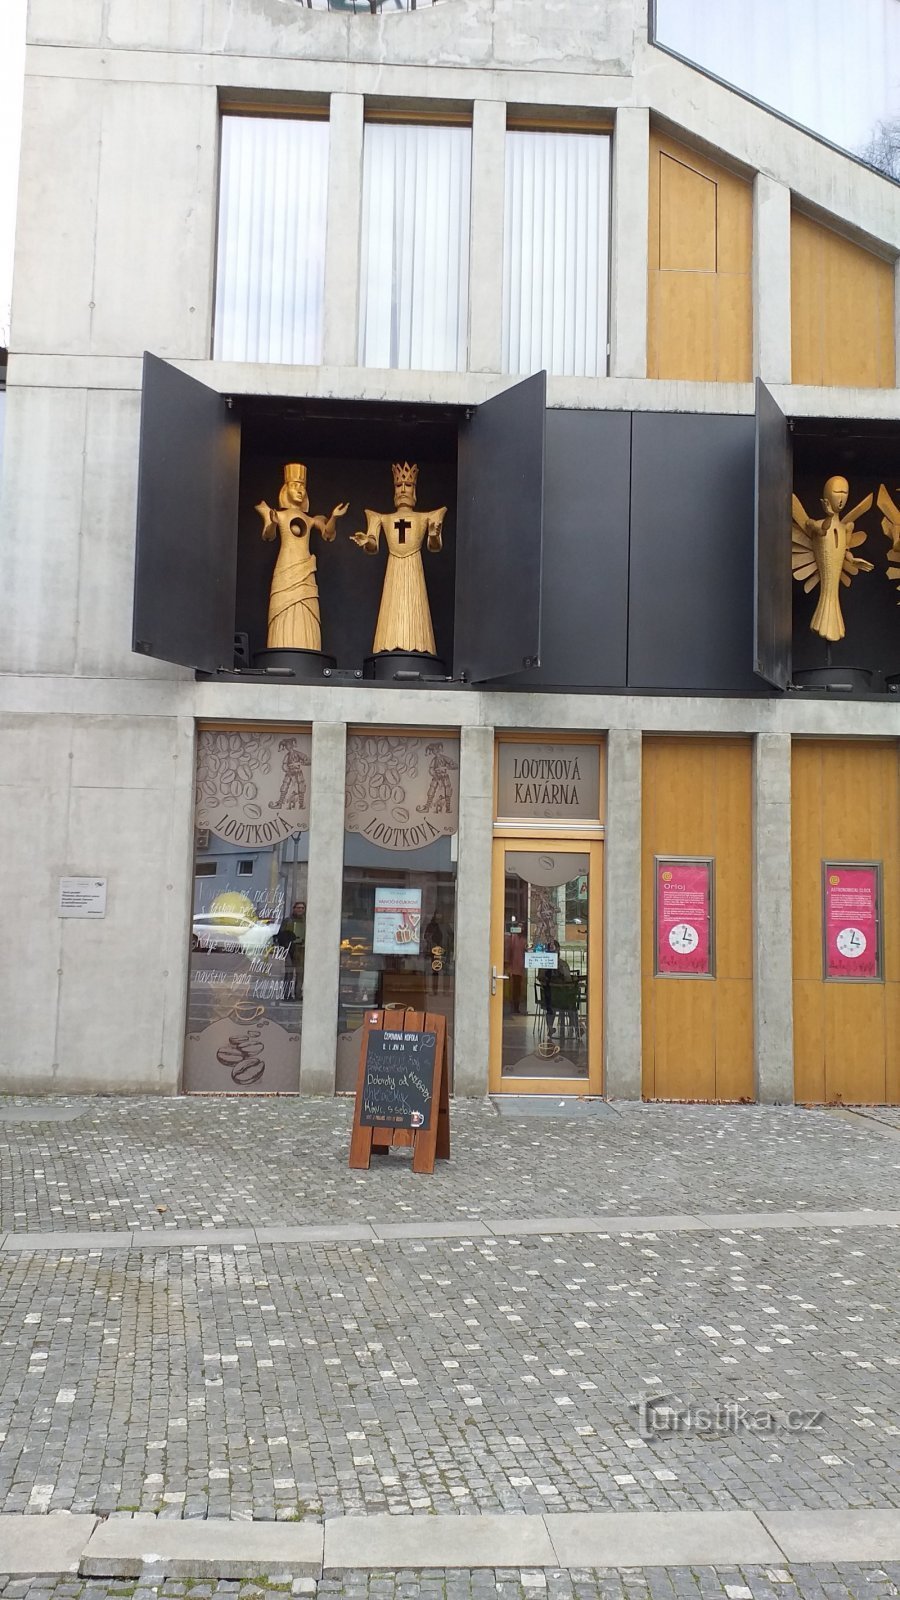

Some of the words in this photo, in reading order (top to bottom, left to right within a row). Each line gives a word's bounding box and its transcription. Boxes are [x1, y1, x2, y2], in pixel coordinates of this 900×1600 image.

[513, 757, 581, 780] LOUTKOVÁ
[514, 780, 579, 804] KAVÁRNA
[214, 812, 293, 843] LOUTKOVÁ
[363, 817, 440, 847] LOUTKOVÁ
[663, 883, 686, 891] Orloj
[367, 1074, 396, 1090] Dobroty
[398, 1074, 410, 1086] od
